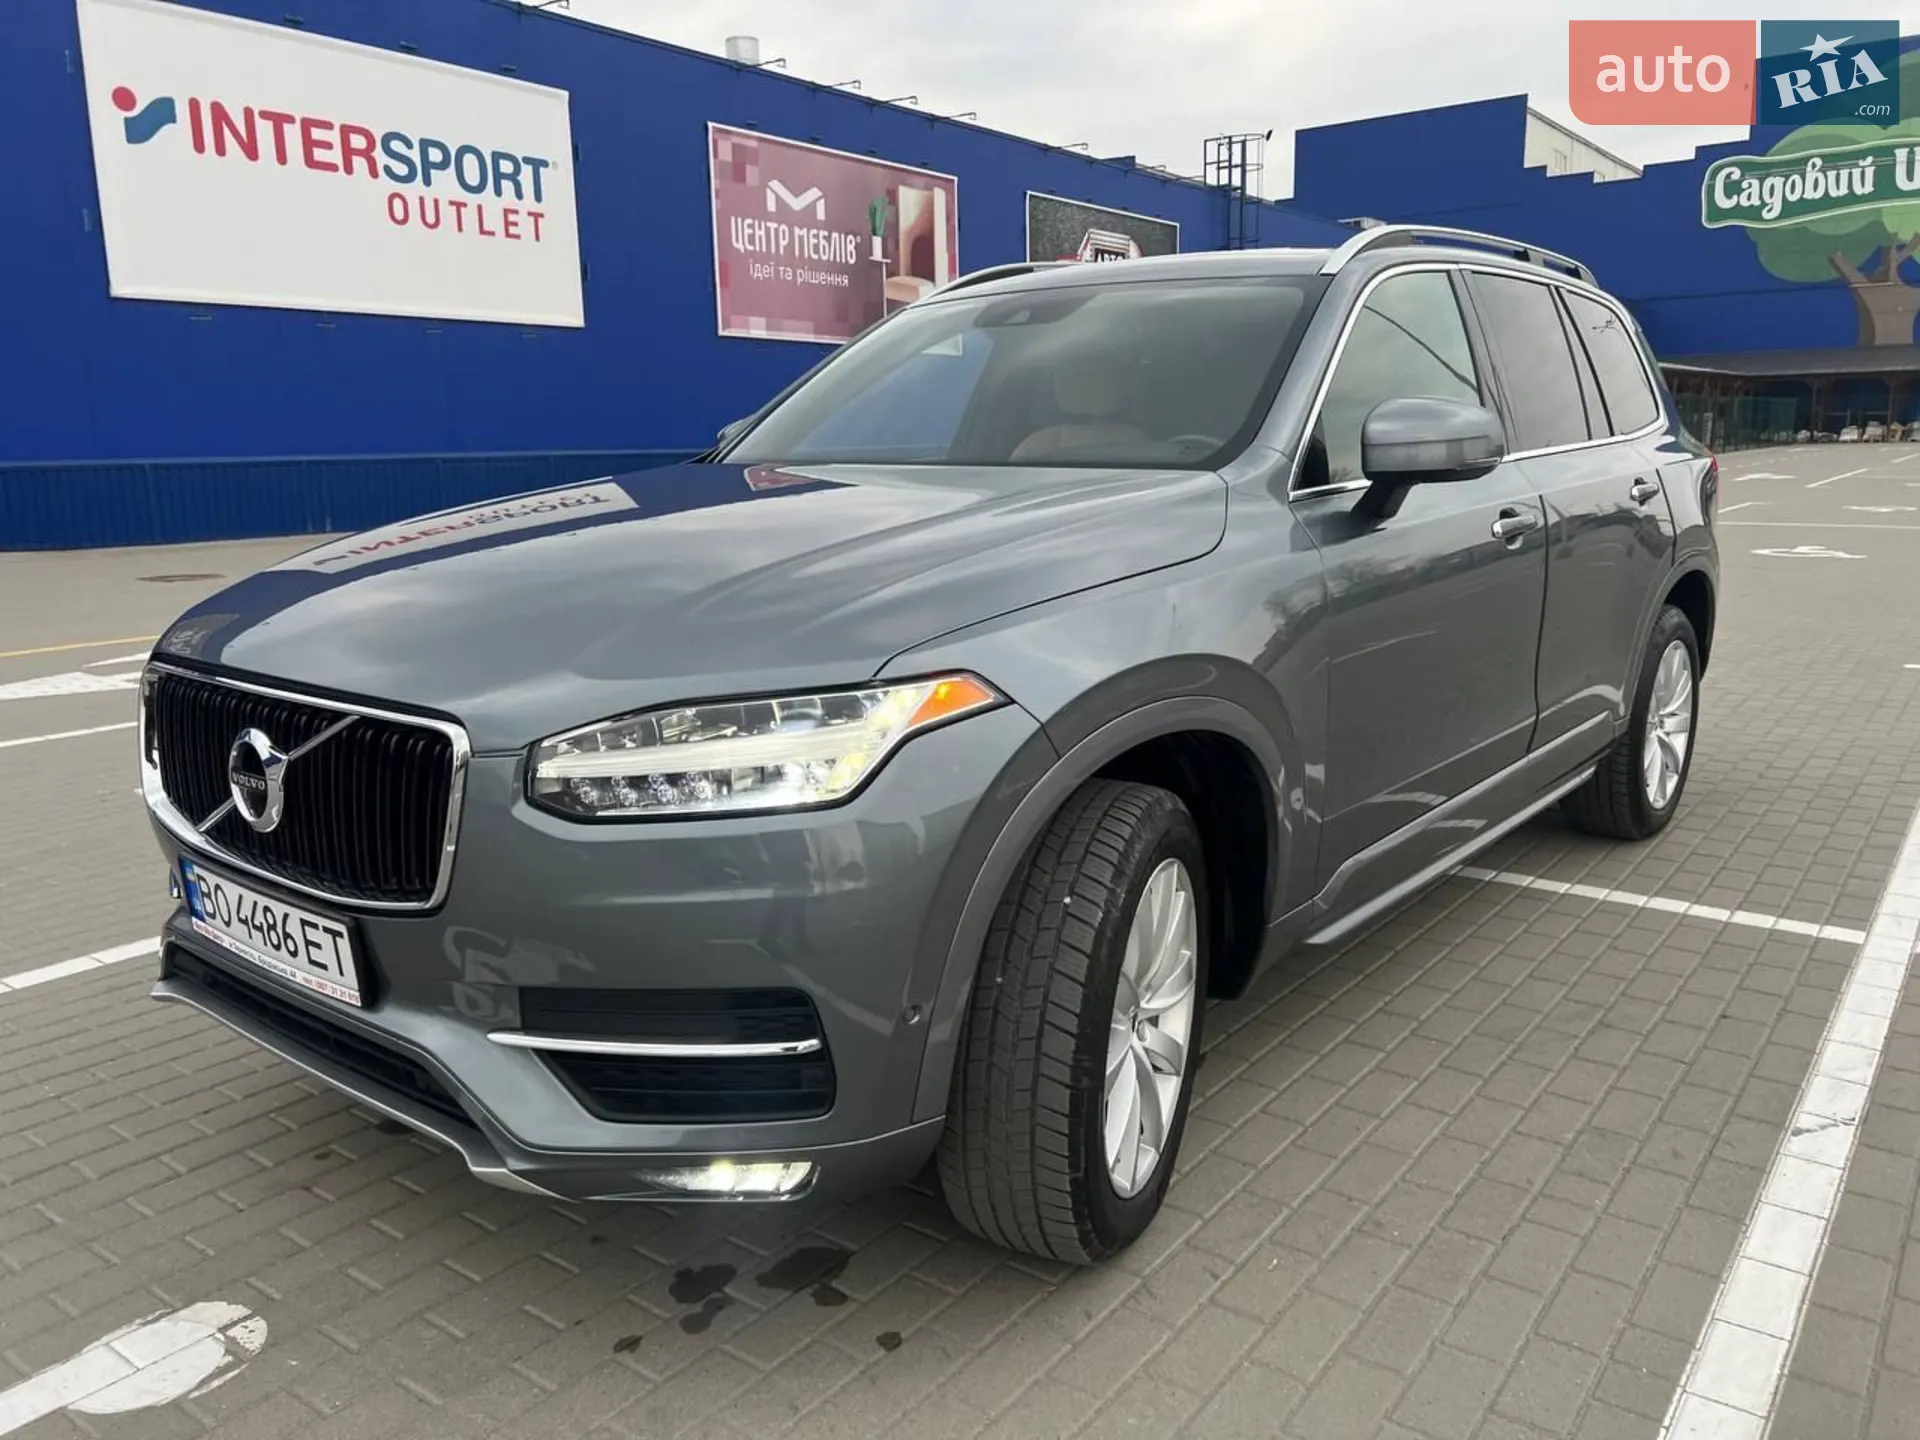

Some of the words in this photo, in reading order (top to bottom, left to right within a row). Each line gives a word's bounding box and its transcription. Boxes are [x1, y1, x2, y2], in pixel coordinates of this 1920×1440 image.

[188, 97, 549, 203] INTERSPORT
[1714, 156, 1875, 220] Садовий
[387, 192, 545, 242] OUTLET
[731, 216, 789, 255] ЦЕНТР
[793, 226, 856, 264] МЕБЛІВ
[778, 266, 793, 280] та
[797, 267, 849, 287] рішення
[232, 772, 266, 790] VOLVO
[237, 894, 299, 958] 4486
[300, 917, 344, 977] ET
